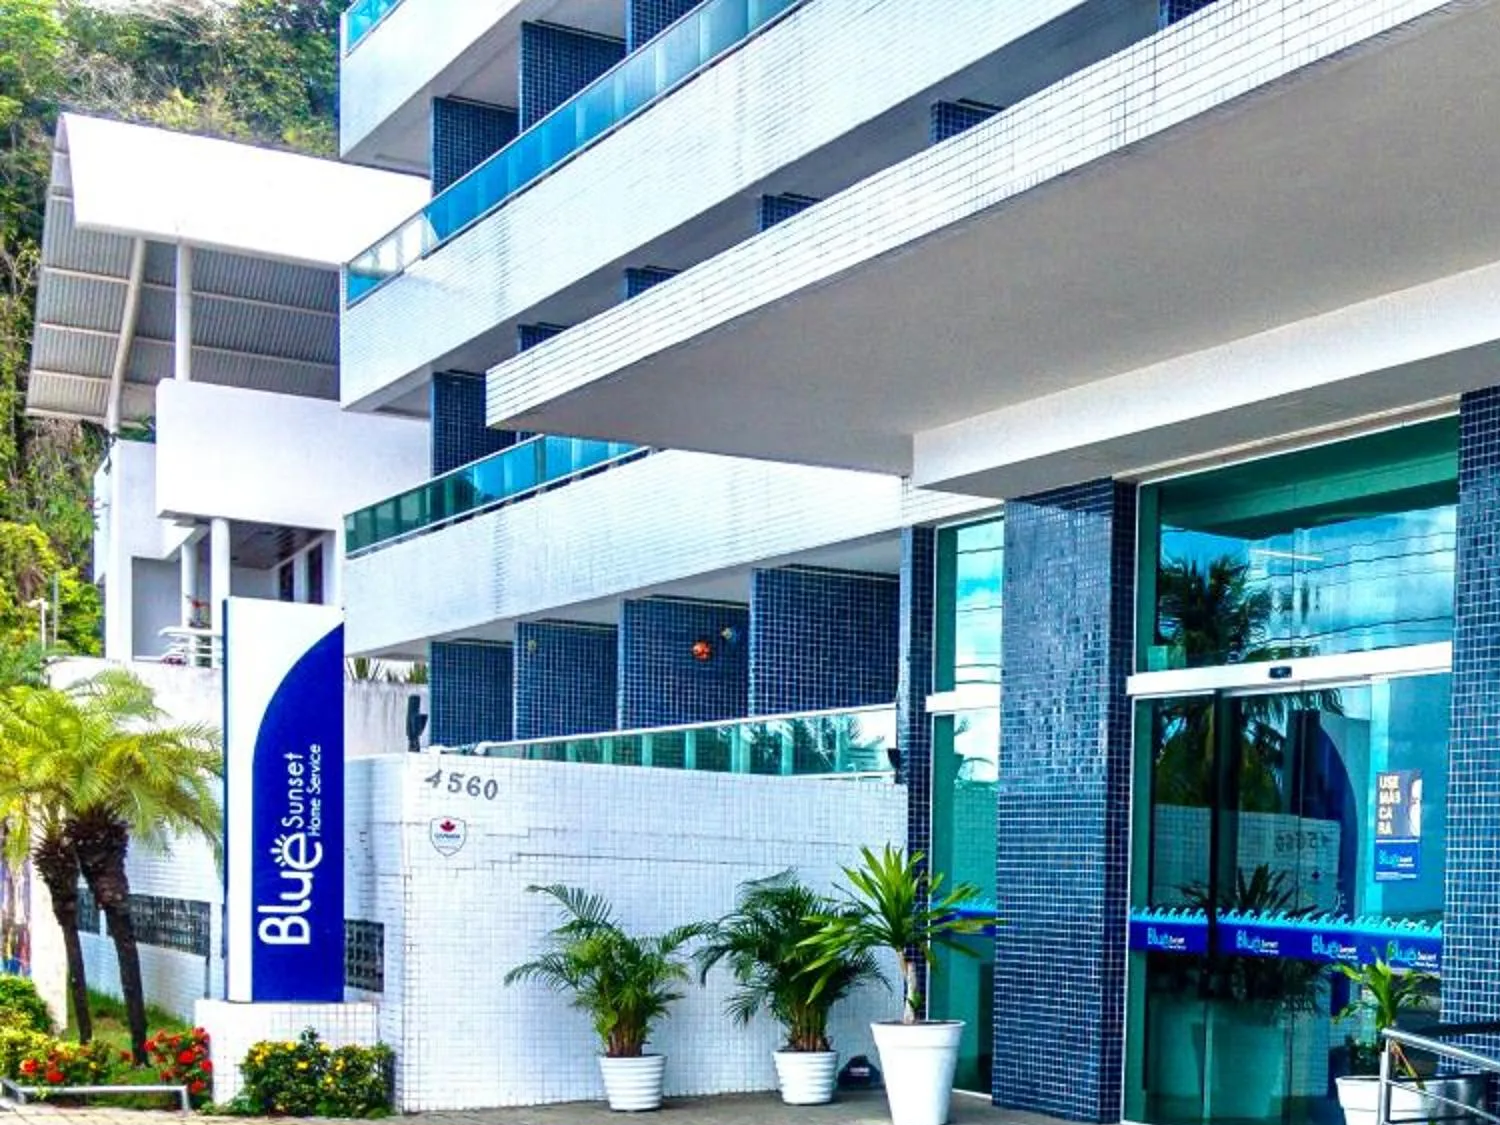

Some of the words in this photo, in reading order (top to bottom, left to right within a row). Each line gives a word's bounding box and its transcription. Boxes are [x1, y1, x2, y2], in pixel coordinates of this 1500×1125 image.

[281, 752, 304, 828] Sunset
[306, 743, 321, 794] Service
[424, 768, 499, 801] 4560
[307, 798, 321, 837] Home
[257, 831, 323, 946] Blue
